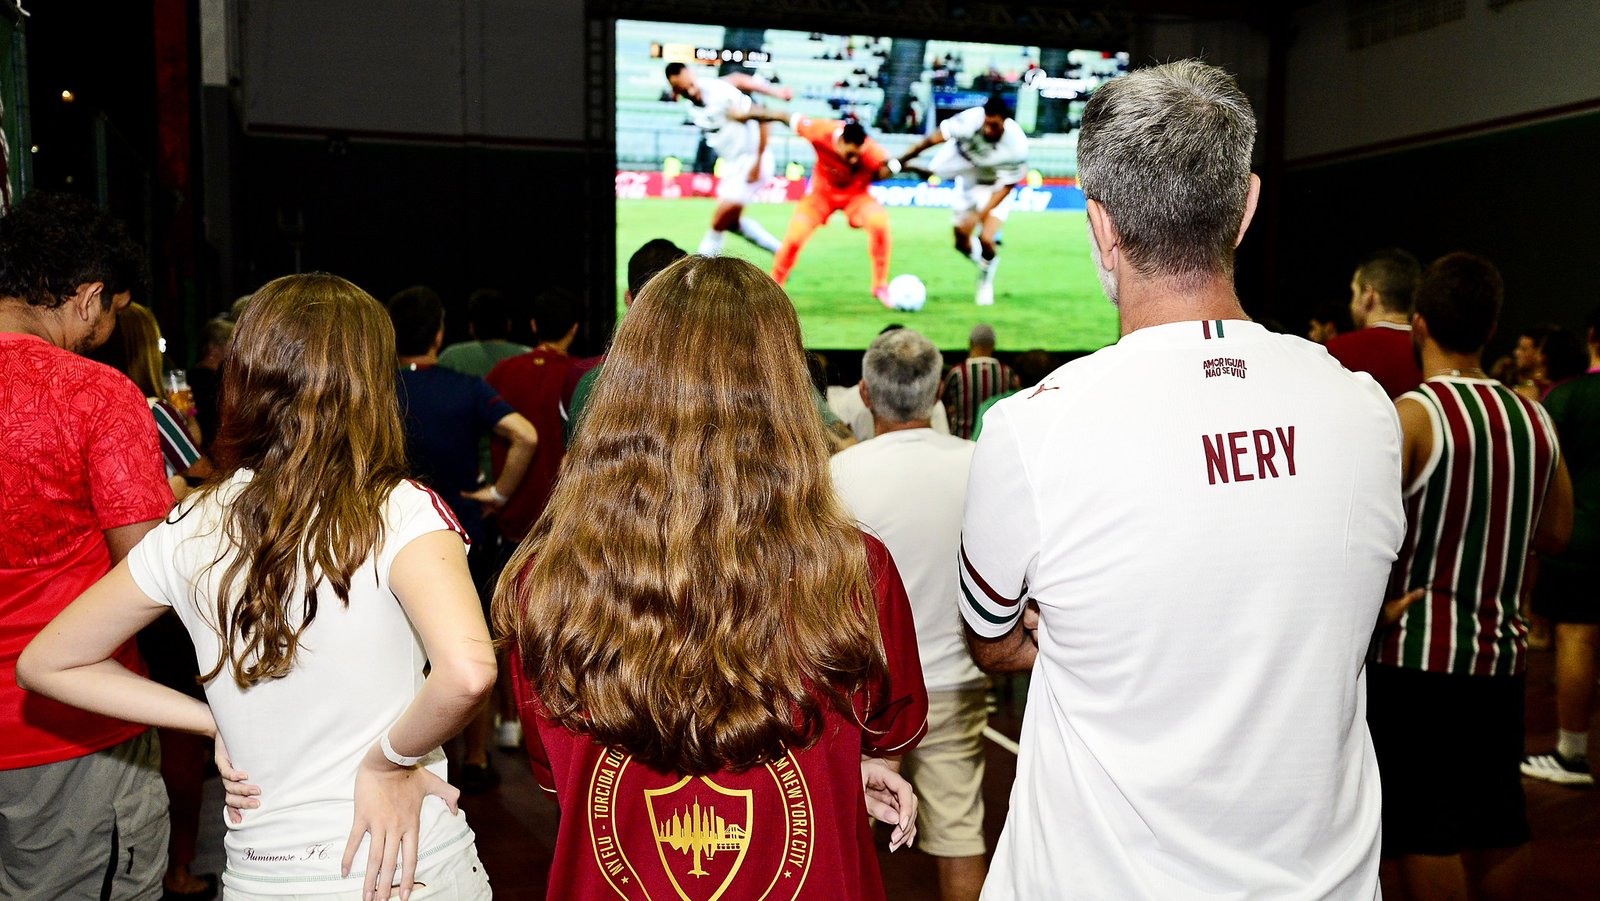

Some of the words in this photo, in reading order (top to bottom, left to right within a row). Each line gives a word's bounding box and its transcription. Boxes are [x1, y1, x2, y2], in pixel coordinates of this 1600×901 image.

[1203, 357, 1224, 370] AMOR
[1224, 357, 1247, 370] IGUAL
[1222, 366, 1231, 375] SE
[1230, 367, 1245, 379] VIU
[1202, 426, 1296, 485] NERY
[594, 768, 616, 820] TORCIDA
[780, 769, 803, 799] NEW
[790, 800, 808, 838] YORK
[241, 847, 296, 862] Fluminense
[597, 836, 617, 859] FLU
[788, 839, 808, 868] CITY
[605, 858, 625, 876] NY
